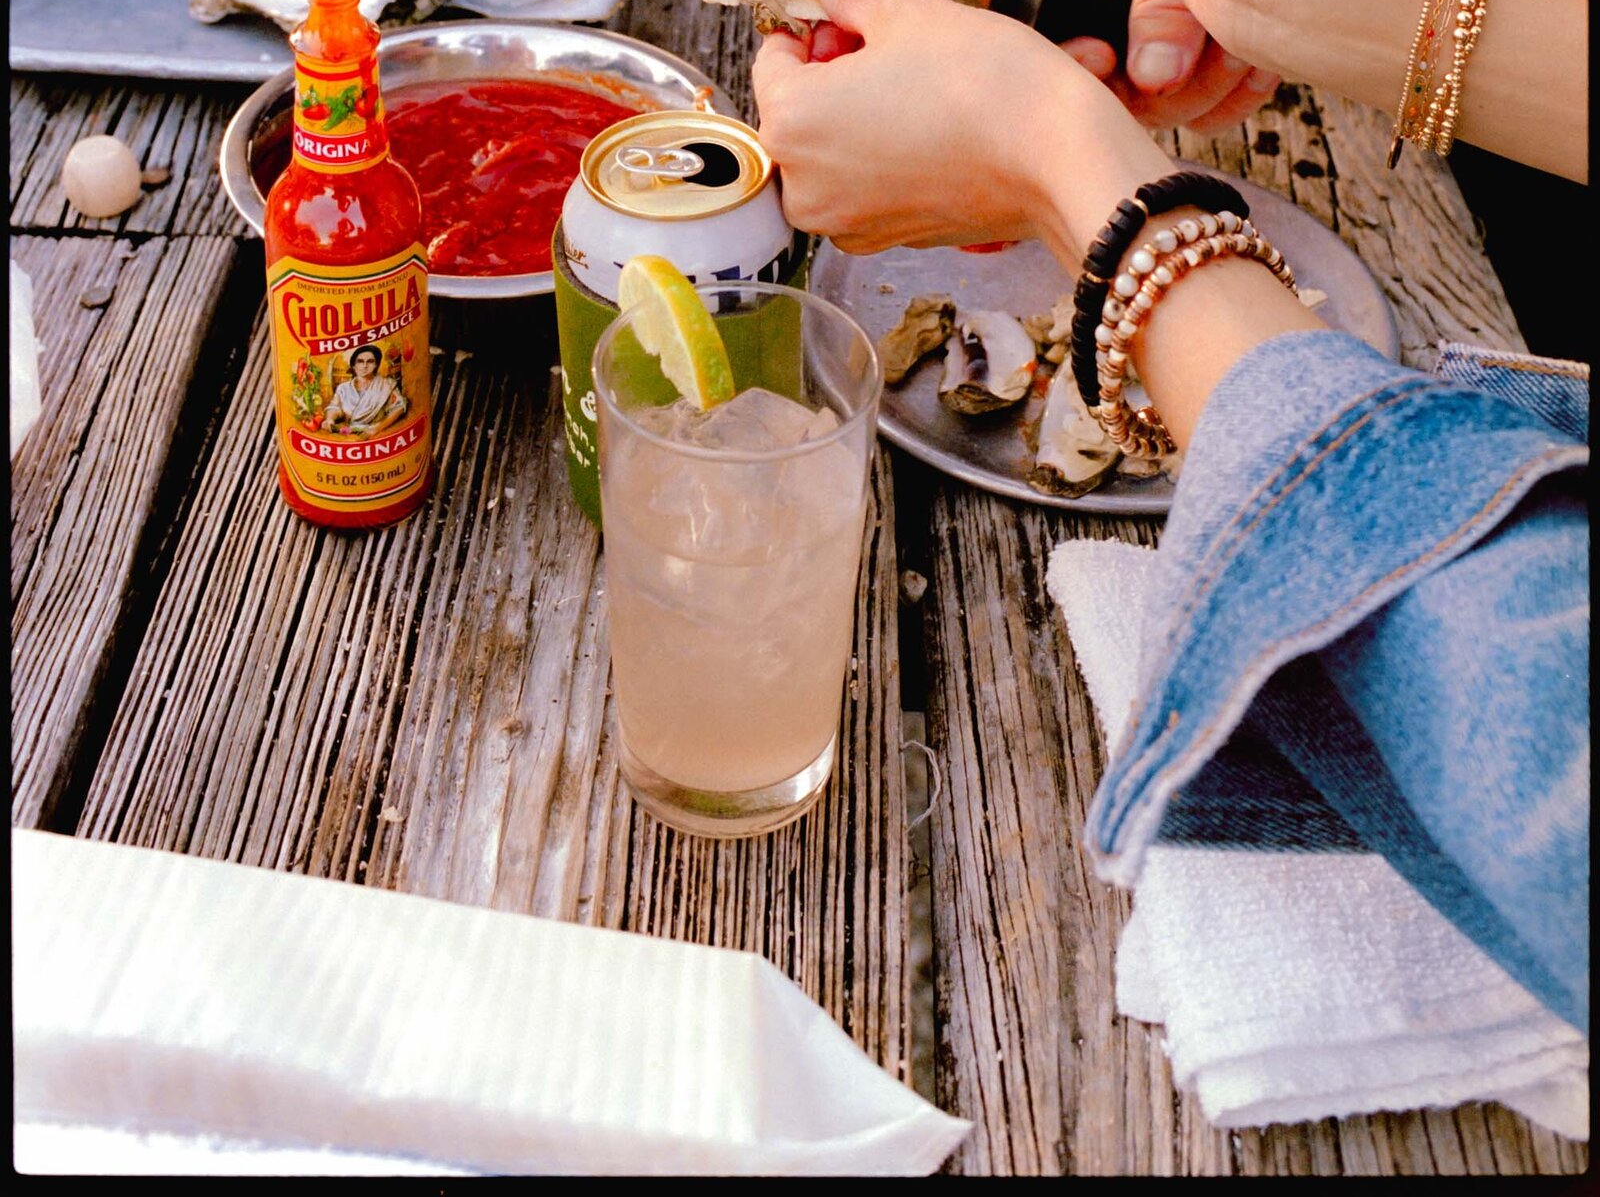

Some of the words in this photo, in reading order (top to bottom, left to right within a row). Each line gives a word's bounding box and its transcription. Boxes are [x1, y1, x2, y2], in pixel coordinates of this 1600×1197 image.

[295, 132, 371, 158] ORIGINA
[297, 283, 345, 295] IMPORTED
[348, 285, 375, 295] FROM
[378, 271, 409, 290] MEXICO
[282, 275, 421, 349] CHOLULA
[319, 334, 361, 353] HOT
[367, 310, 415, 343] SAUCE
[300, 428, 418, 461] ORIGINAL
[316, 471, 324, 483] 5
[326, 474, 339, 486] FL
[342, 475, 358, 486] OZ
[360, 473, 385, 485] (150
[387, 463, 407, 480] mL)
